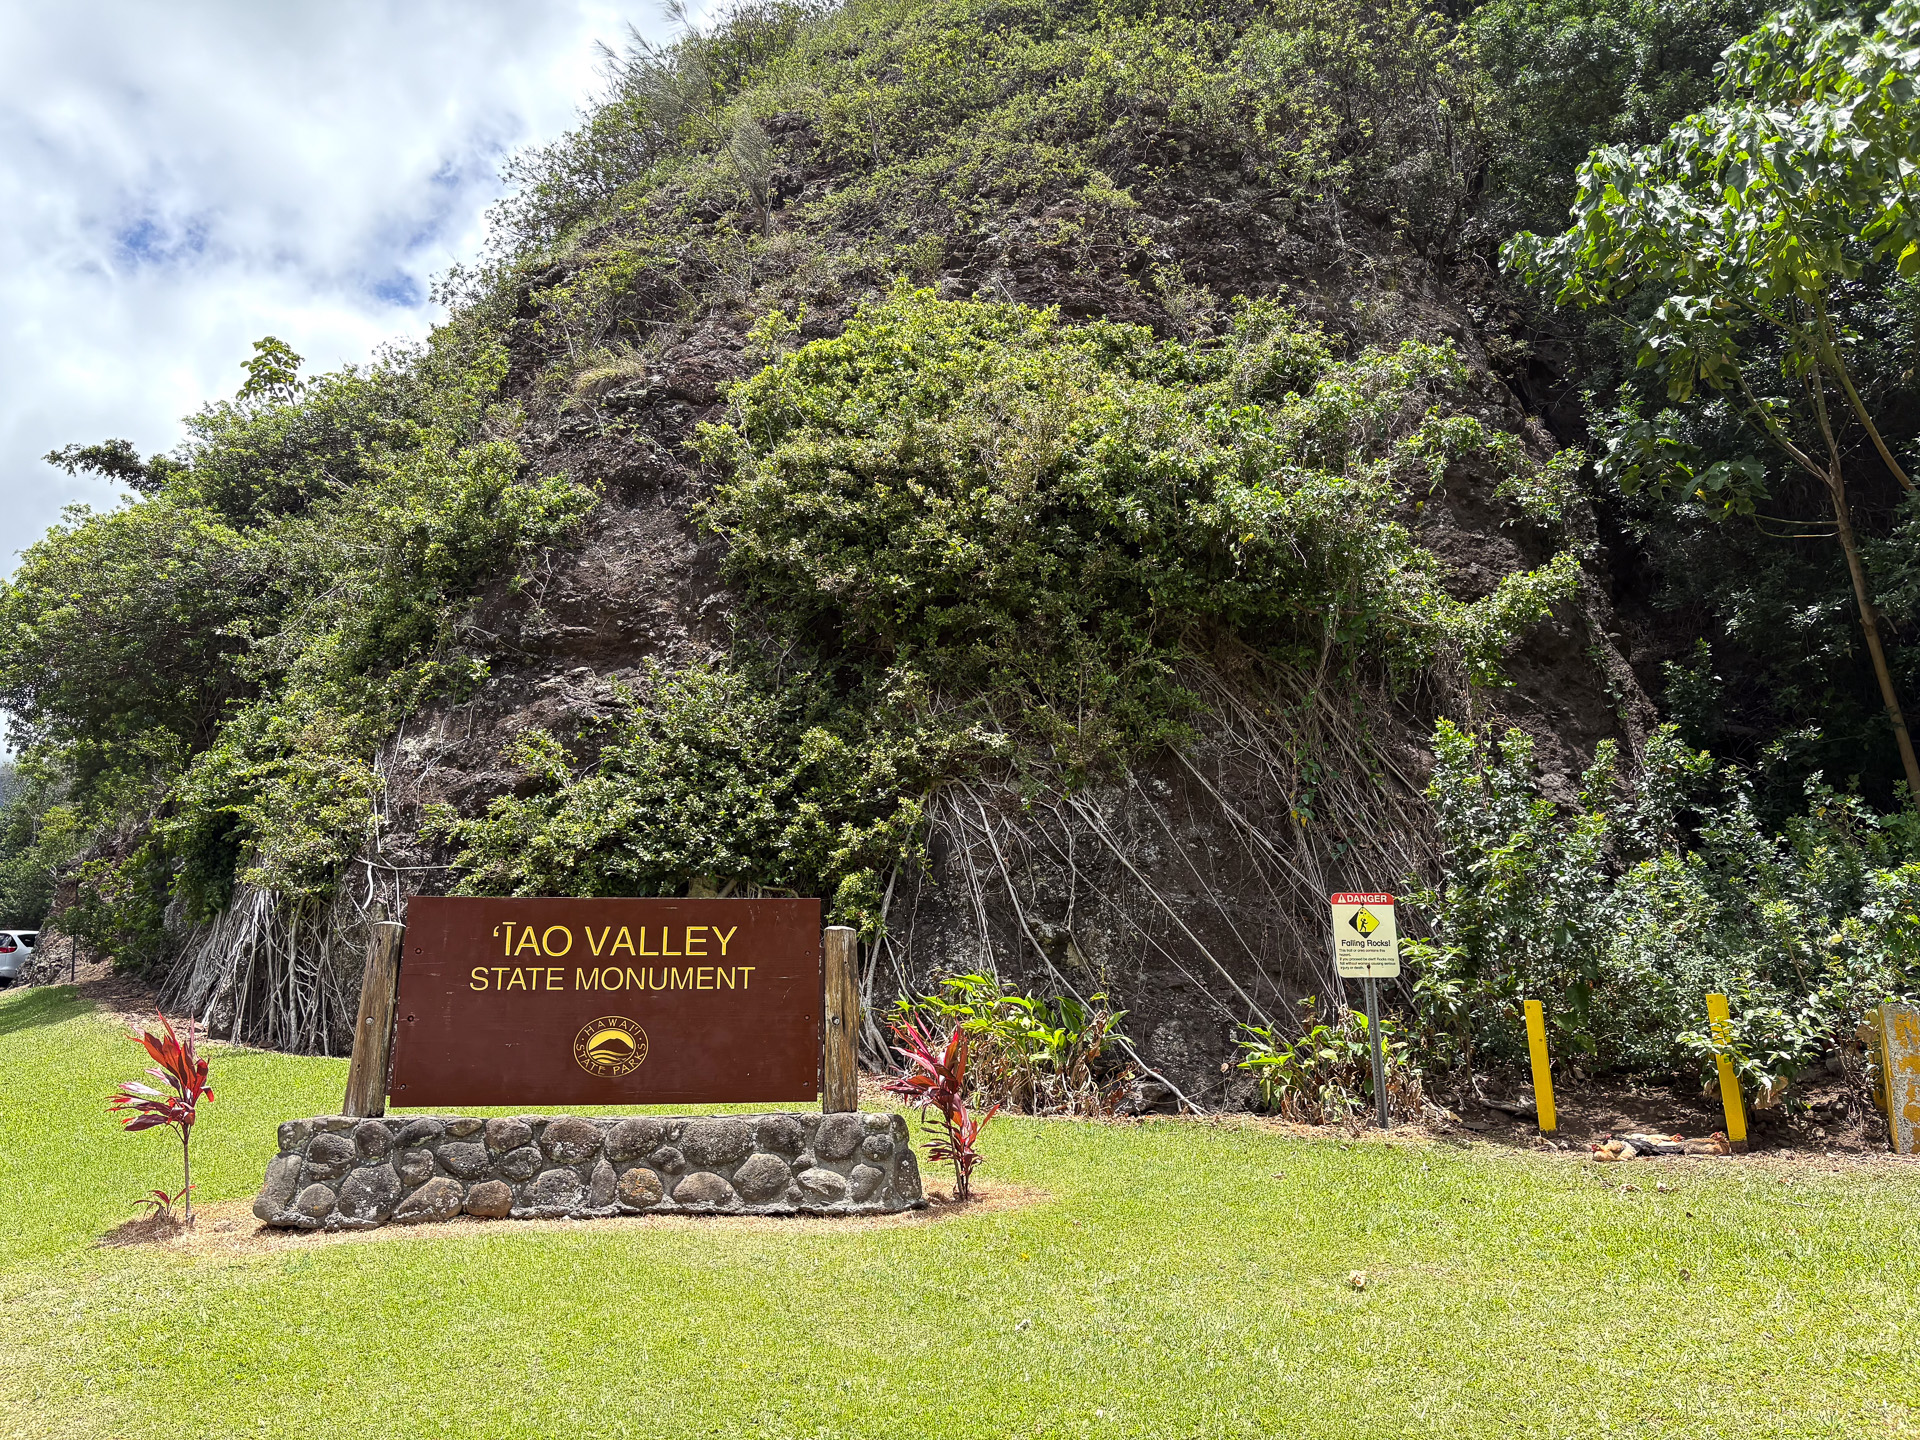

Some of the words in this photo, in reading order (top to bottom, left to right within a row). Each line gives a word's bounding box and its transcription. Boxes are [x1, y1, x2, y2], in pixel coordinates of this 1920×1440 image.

[1346, 895, 1387, 903] DANGER
[584, 925, 738, 957] VALLEY
[1341, 939, 1365, 948] Falling
[1366, 939, 1391, 947] Rocks!
[469, 966, 565, 991] STATE
[575, 966, 756, 991] MONUMENT
[575, 1043, 606, 1075] STATE
[613, 1043, 647, 1075] PARKS
